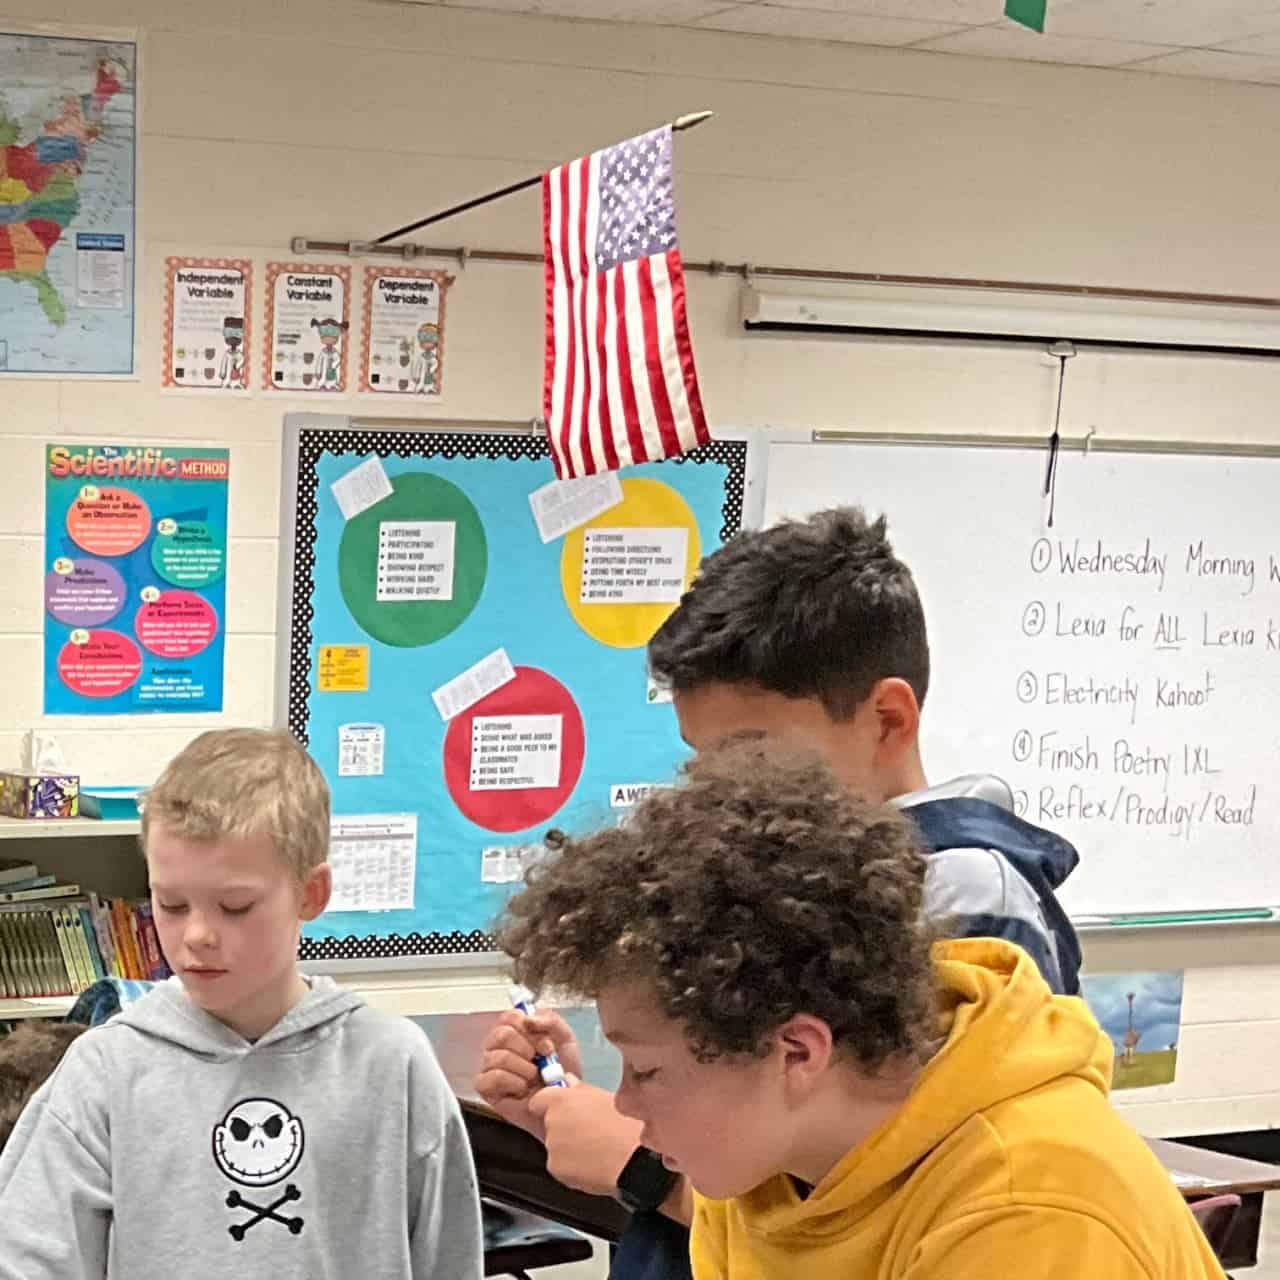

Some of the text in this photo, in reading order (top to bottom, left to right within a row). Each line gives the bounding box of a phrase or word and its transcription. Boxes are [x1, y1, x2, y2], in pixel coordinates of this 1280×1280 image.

[177, 271, 244, 286] Independent
[287, 276, 333, 289] Constant
[379, 279, 434, 293] Dependent
[187, 286, 234, 300] Variable
[287, 289, 333, 302] Variable
[384, 292, 429, 305] Variable
[50, 447, 226, 477] Scientific METHOD
[1058, 538, 1167, 592] Wednesday
[1185, 540, 1255, 596] Morning
[1055, 601, 1106, 638] Lexia
[1119, 605, 1144, 642] for
[1153, 612, 1187, 644] ALL
[1202, 611, 1255, 647] Lexia
[1045, 672, 1139, 725] Electricity
[1155, 670, 1216, 708] Kahoot
[1037, 731, 1099, 772] Finish
[1113, 738, 1172, 792] Poetry
